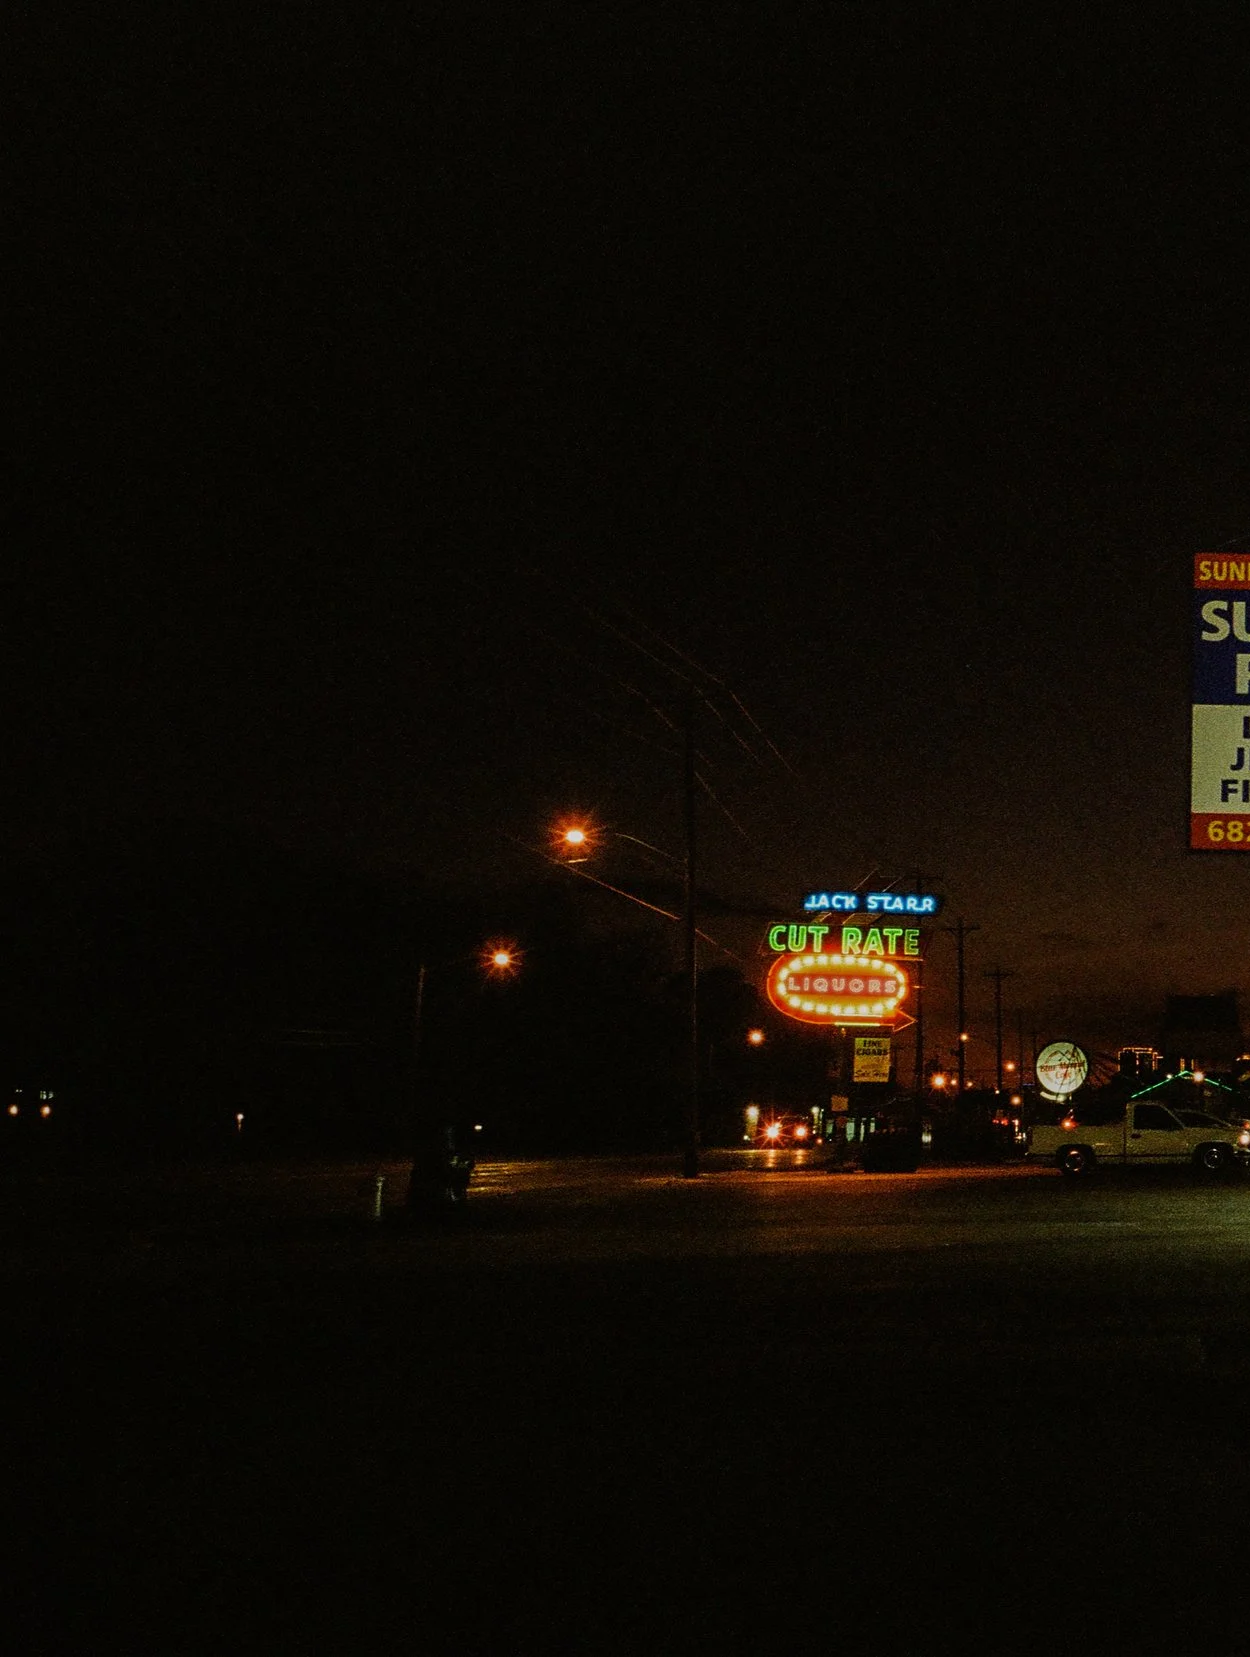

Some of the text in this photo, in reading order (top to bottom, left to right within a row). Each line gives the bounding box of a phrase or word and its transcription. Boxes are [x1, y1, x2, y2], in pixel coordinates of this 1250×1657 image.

[804, 893, 937, 912] JACK STARR
[769, 923, 921, 955] CUT RATE
[788, 976, 898, 994] LIQUORS
